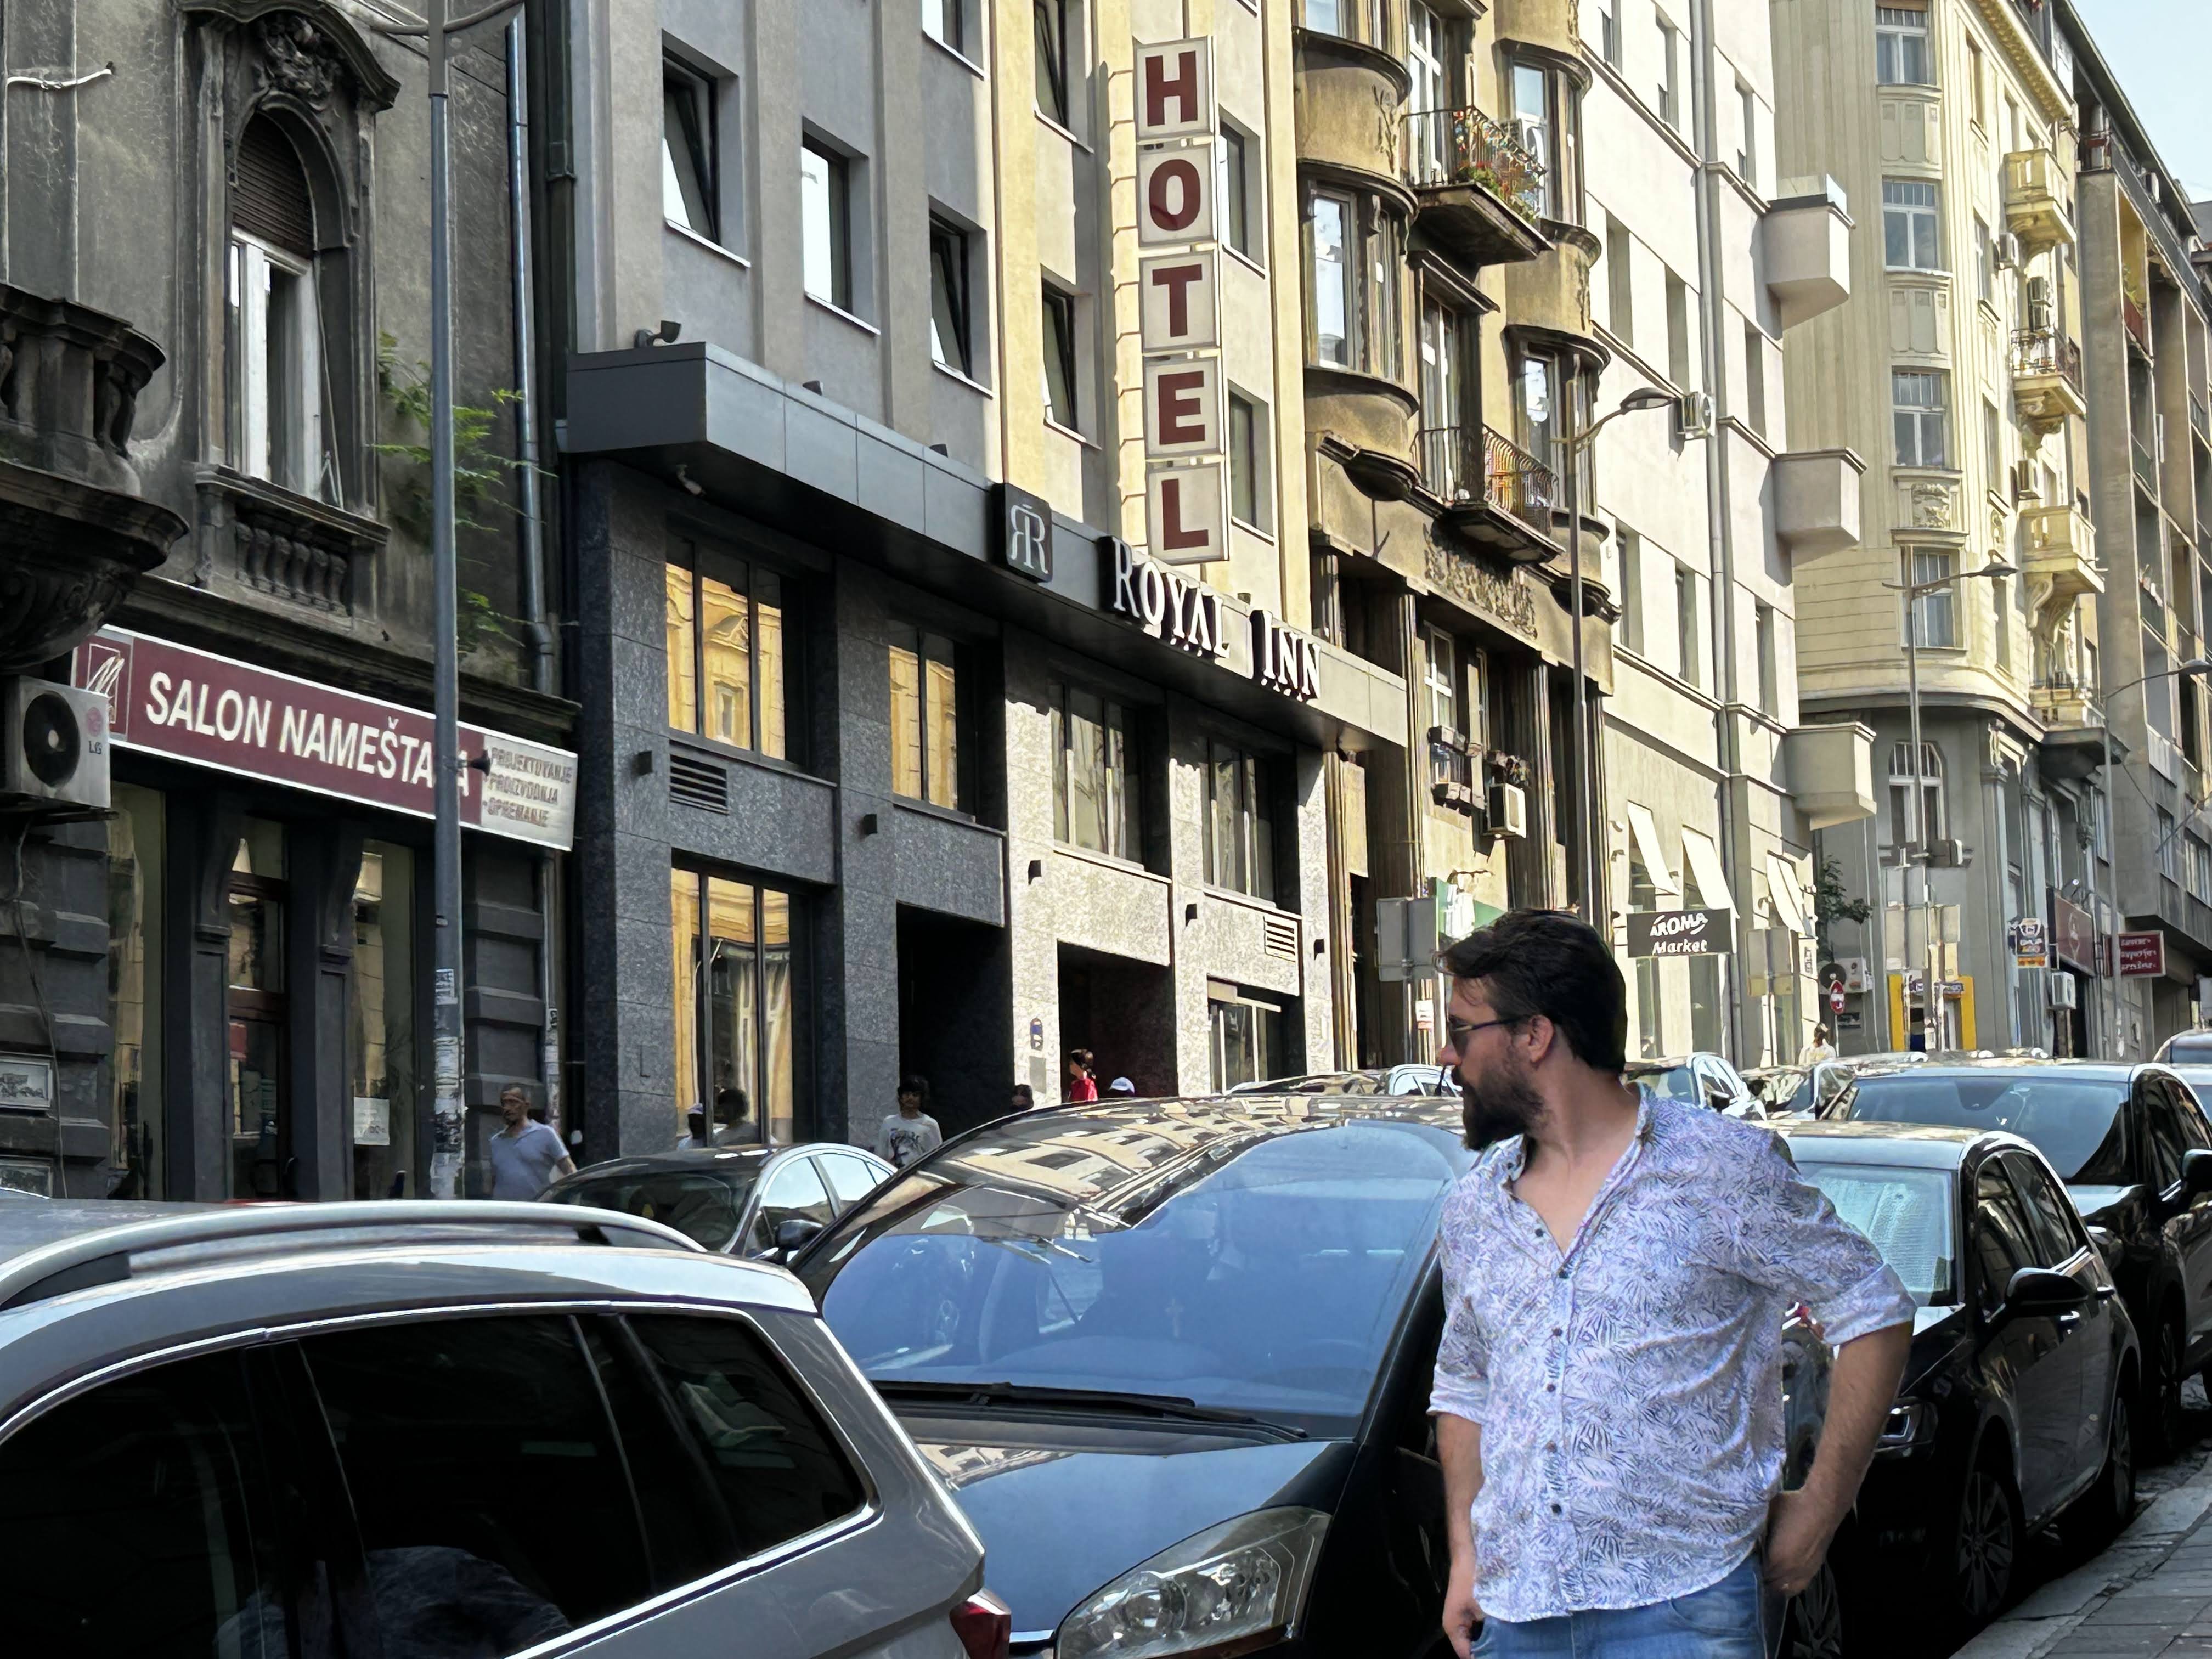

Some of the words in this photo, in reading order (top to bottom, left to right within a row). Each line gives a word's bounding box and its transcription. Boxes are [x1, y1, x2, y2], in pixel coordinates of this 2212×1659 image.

[1145, 51, 1209, 551] HOTEL
[1113, 535, 1231, 658] ROYAL
[1262, 609, 1321, 699] INN
[146, 672, 272, 748] SALON
[279, 706, 469, 797] NAMEŠTAA
[1650, 913, 1708, 936] AROMA
[1652, 939, 1708, 956] Market
